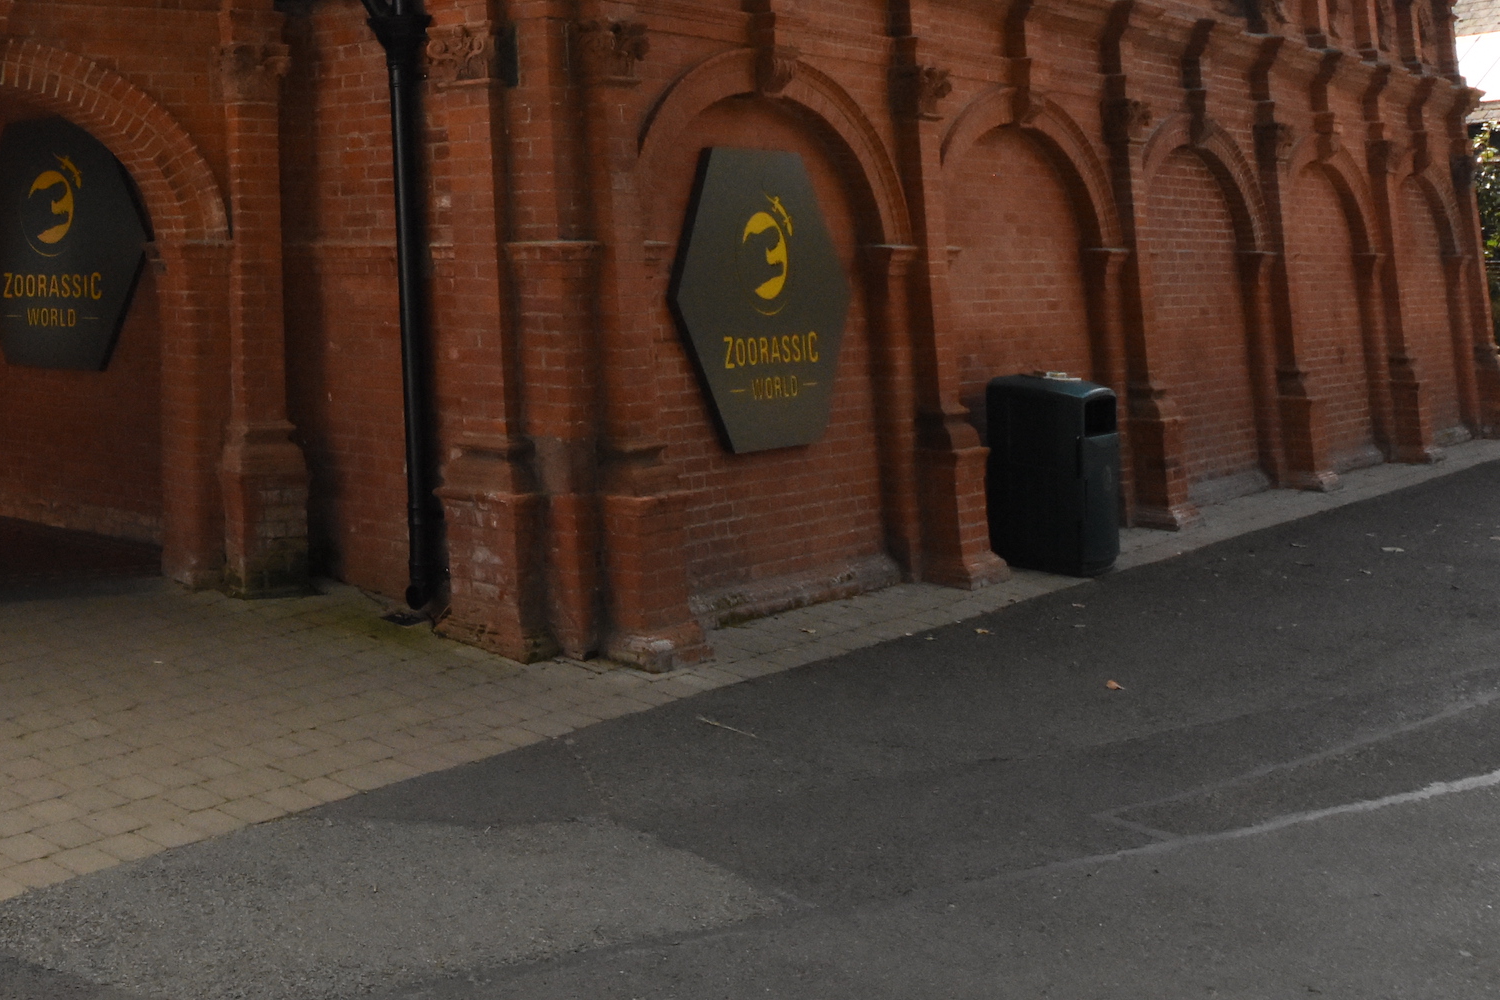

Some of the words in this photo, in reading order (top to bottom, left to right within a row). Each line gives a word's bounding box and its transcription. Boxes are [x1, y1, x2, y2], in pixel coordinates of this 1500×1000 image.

[3, 272, 103, 300] ZOORASSIC
[27, 308, 77, 327] WORLD
[723, 331, 819, 370] ZOORASSIC
[752, 375, 798, 400] WORLD
